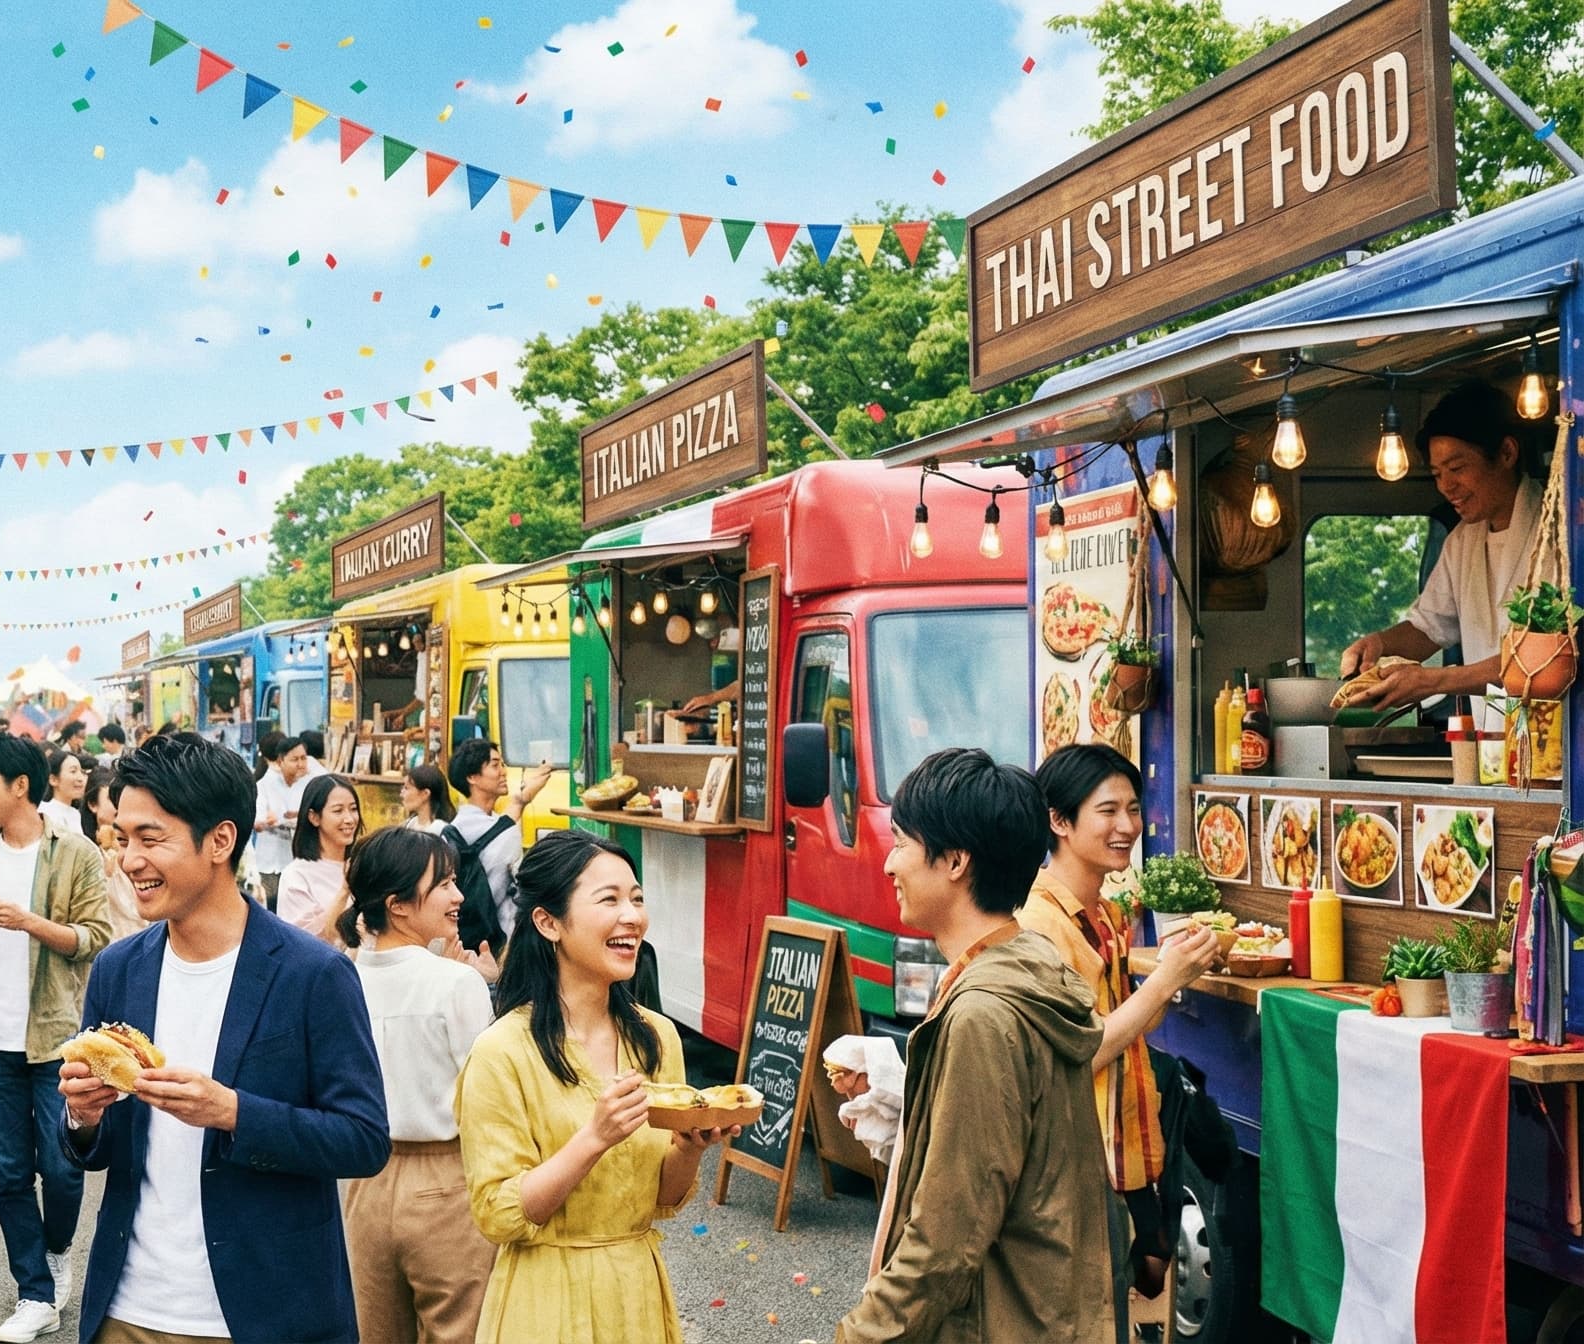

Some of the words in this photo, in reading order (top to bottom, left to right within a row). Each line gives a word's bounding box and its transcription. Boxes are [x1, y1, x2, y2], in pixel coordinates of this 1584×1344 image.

[986, 217, 1073, 333] THAI
[1087, 125, 1251, 290] STREET
[1269, 51, 1410, 209] FOOD
[593, 421, 666, 499] ITALIAN
[672, 390, 740, 468] PIZZA
[383, 518, 433, 568] CURRY
[765, 984, 805, 1022] PIZZA
